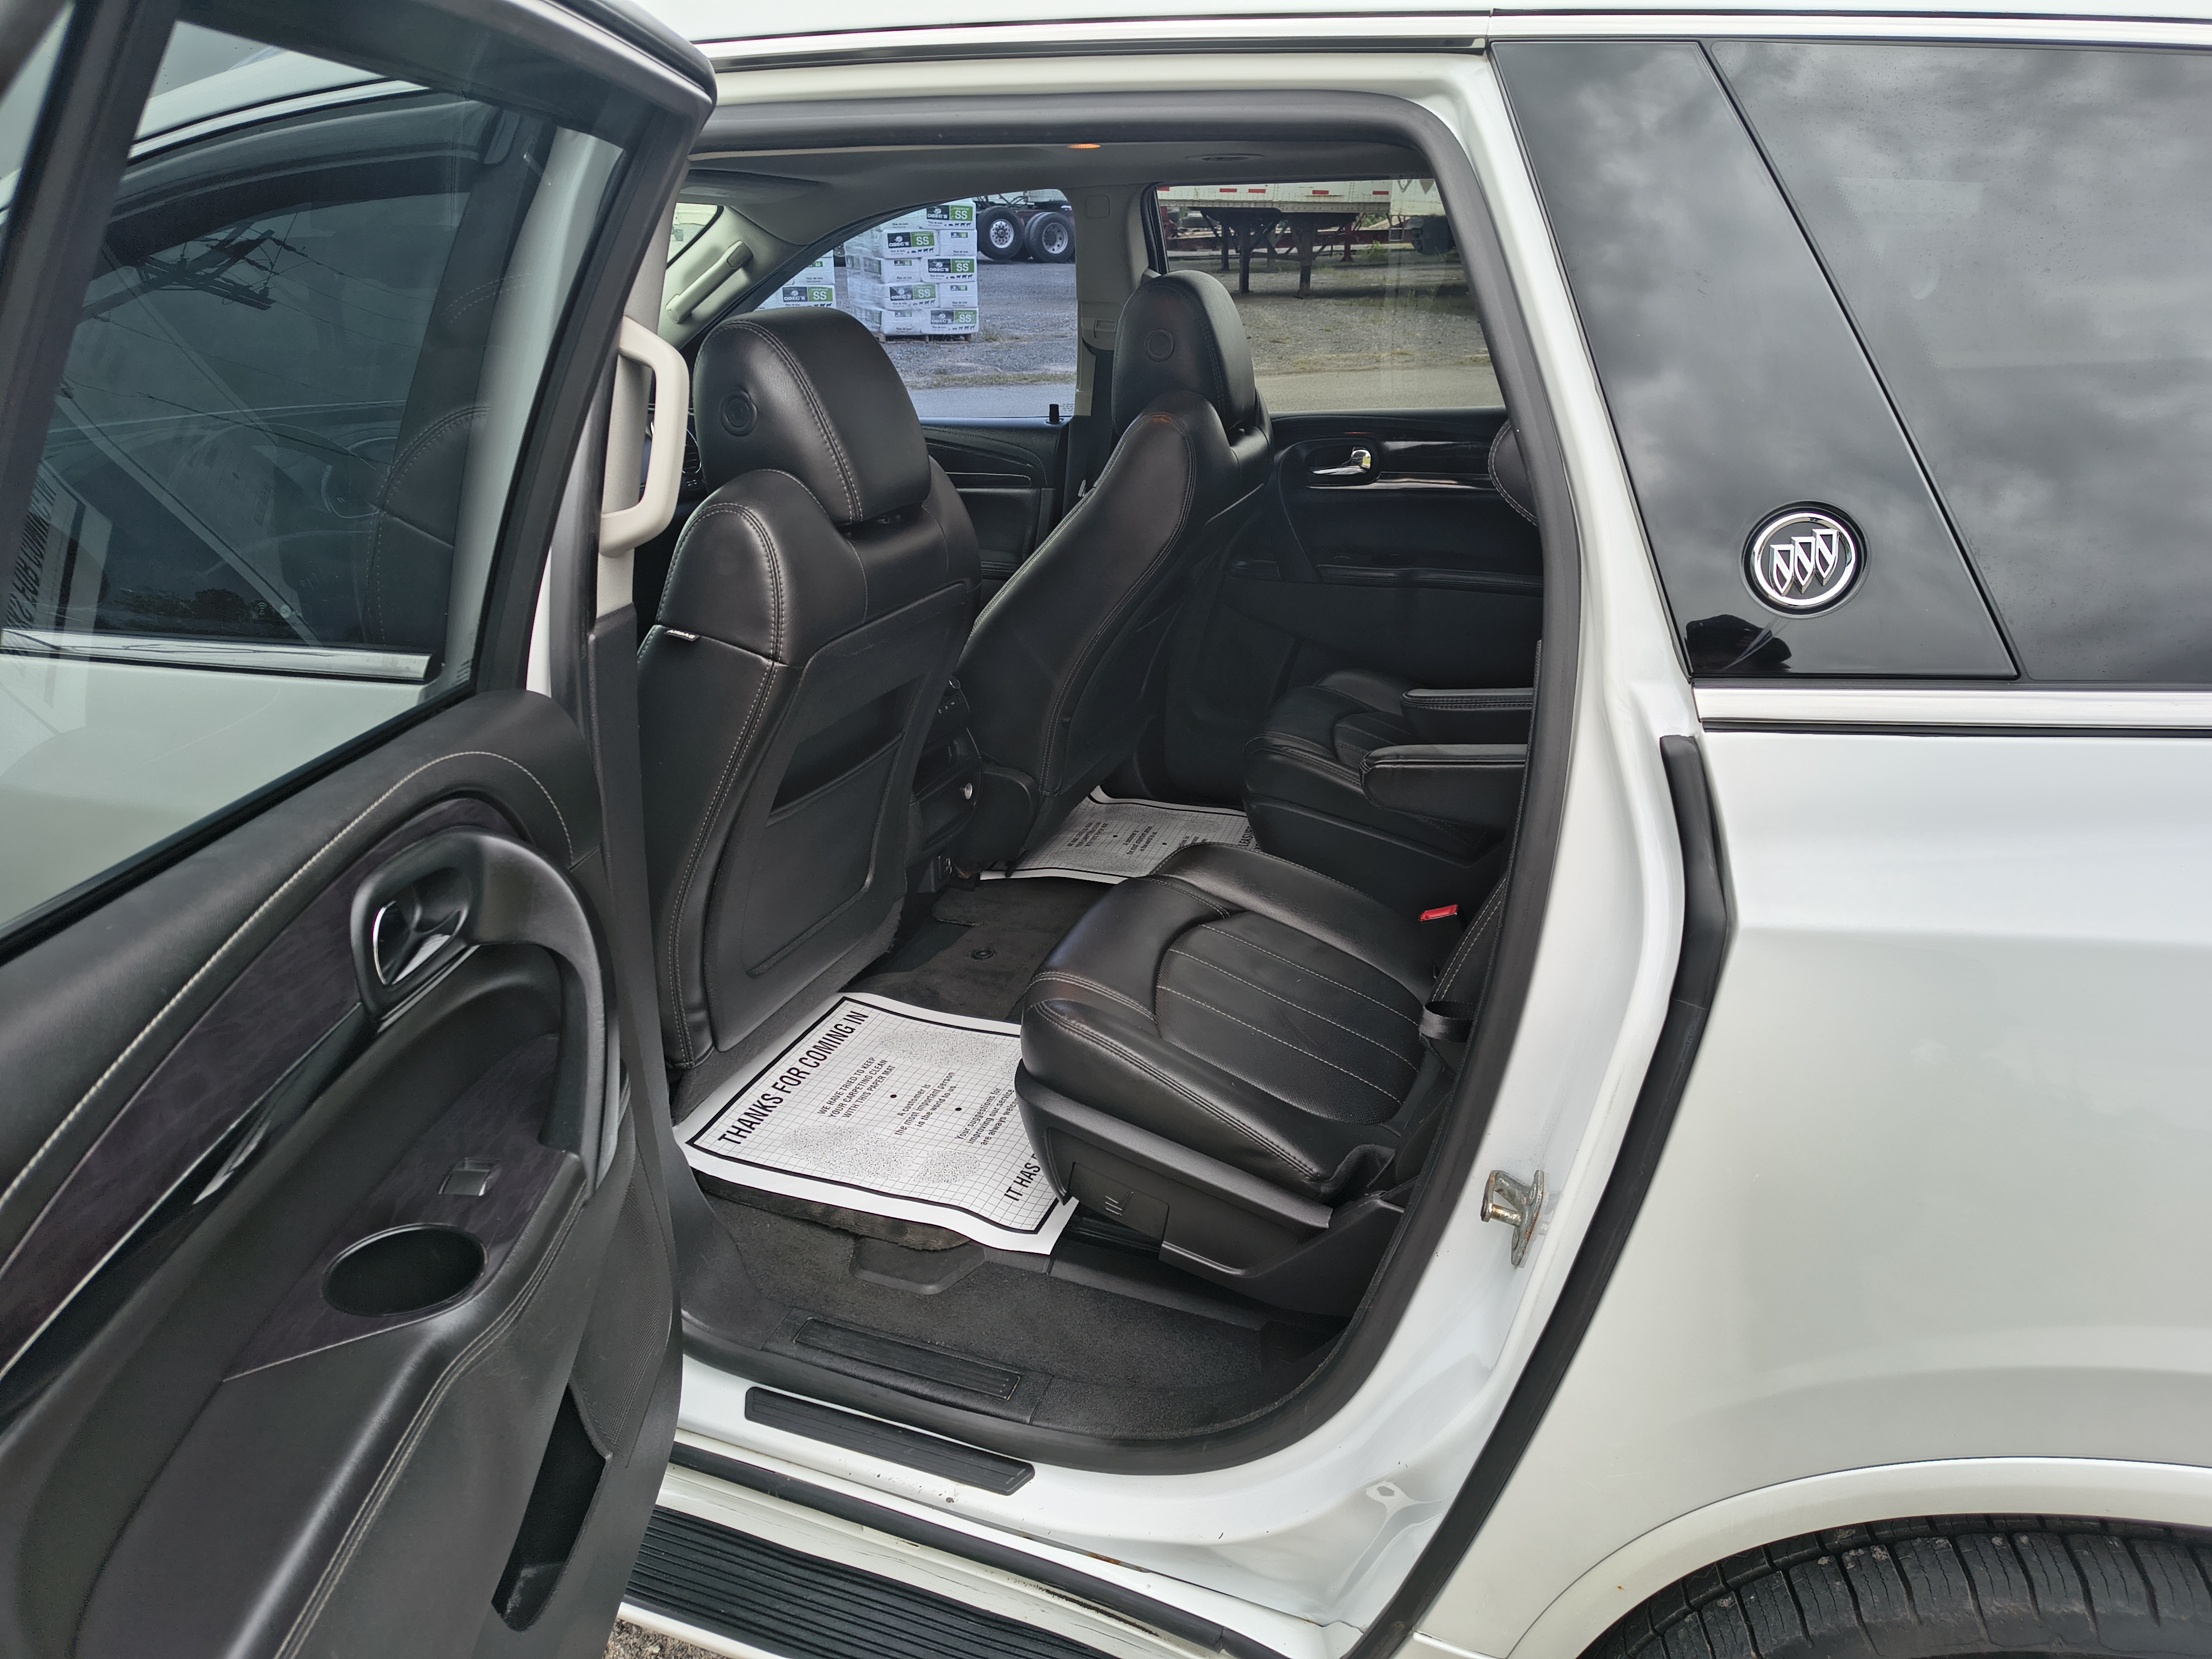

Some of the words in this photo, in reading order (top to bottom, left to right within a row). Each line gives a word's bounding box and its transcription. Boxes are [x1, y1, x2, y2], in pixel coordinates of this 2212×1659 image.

[955, 210, 968, 219] SS
[916, 236, 929, 245] SS
[956, 263, 969, 271] SS
[813, 291, 827, 300] SS
[918, 289, 930, 298] SS
[959, 314, 972, 322] SS
[1238, 826, 1253, 846] LEASUR
[718, 1093, 783, 1144] THANKS
[772, 1067, 811, 1094] FOR
[799, 1024, 856, 1068] COMING
[843, 1010, 869, 1025] IN
[817, 1105, 831, 1115] WE
[826, 1091, 844, 1105] HAVE
[839, 1076, 857, 1091] TRIED
[861, 1057, 875, 1069] KEEP
[828, 1103, 847, 1117] YOUR
[843, 1075, 873, 1103] CARPETING
[869, 1059, 888, 1075] CLEAN
[842, 1104, 860, 1118] WITH
[855, 1091, 871, 1103] THIS
[867, 1076, 886, 1091] PAPER
[882, 1065, 895, 1076] MAT
[902, 1089, 926, 1112] customer
[894, 1126, 907, 1135] the
[903, 1112, 919, 1125] most
[916, 1089, 941, 1111] important
[938, 1072, 955, 1090] person
[921, 1111, 933, 1120] the
[929, 1098, 946, 1111] world
[955, 1128, 970, 1139] Your
[967, 1095, 995, 1127] suggestions
[966, 1117, 994, 1144] improving
[989, 1107, 1000, 1117] our
[996, 1089, 1015, 1107] service
[980, 1136, 992, 1145] are
[988, 1116, 1007, 1135] always
[1003, 1098, 1019, 1115] welco
[1013, 1162, 1041, 1188] HAS
[1004, 1186, 1023, 1201] IT
